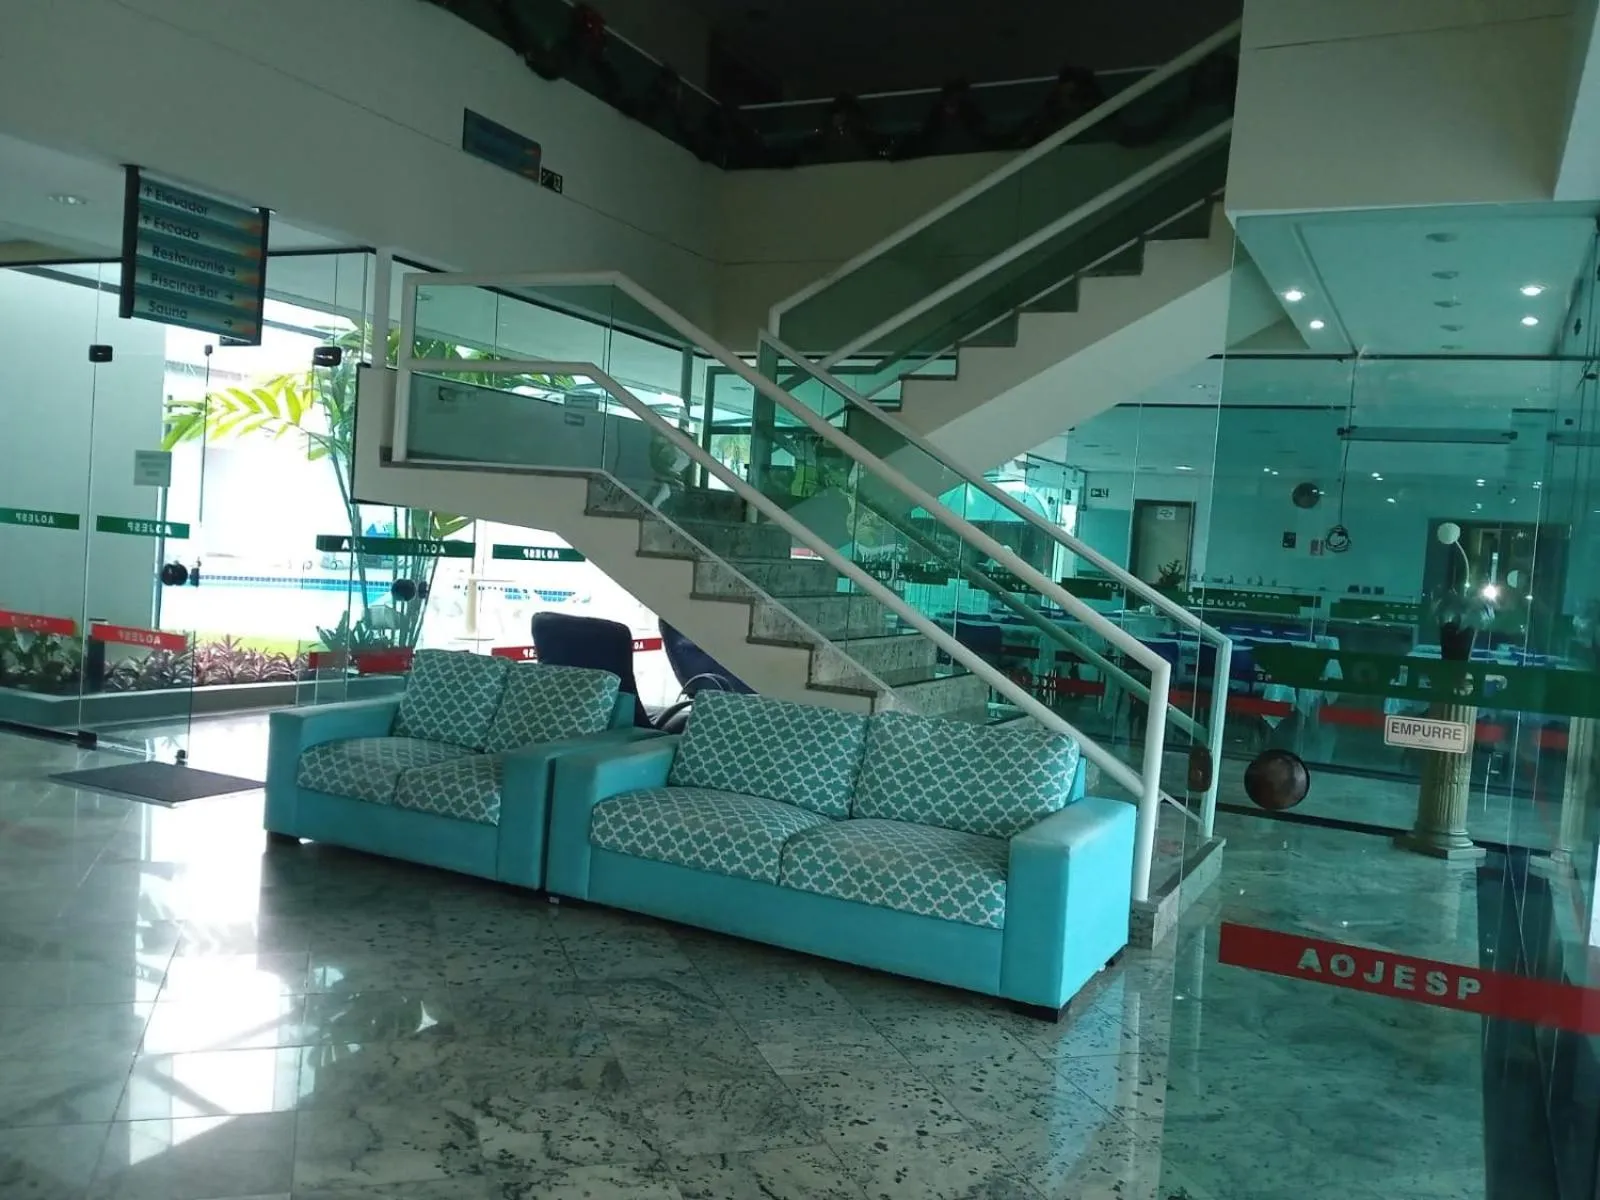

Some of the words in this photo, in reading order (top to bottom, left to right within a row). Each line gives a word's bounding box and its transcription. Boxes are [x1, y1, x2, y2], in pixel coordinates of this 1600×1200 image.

[154, 218, 199, 240] Escada
[152, 244, 225, 274] Restaurante
[148, 300, 188, 319] Sauna
[1391, 721, 1462, 741] EMPURRE
[1297, 947, 1482, 1001] AOJESP
